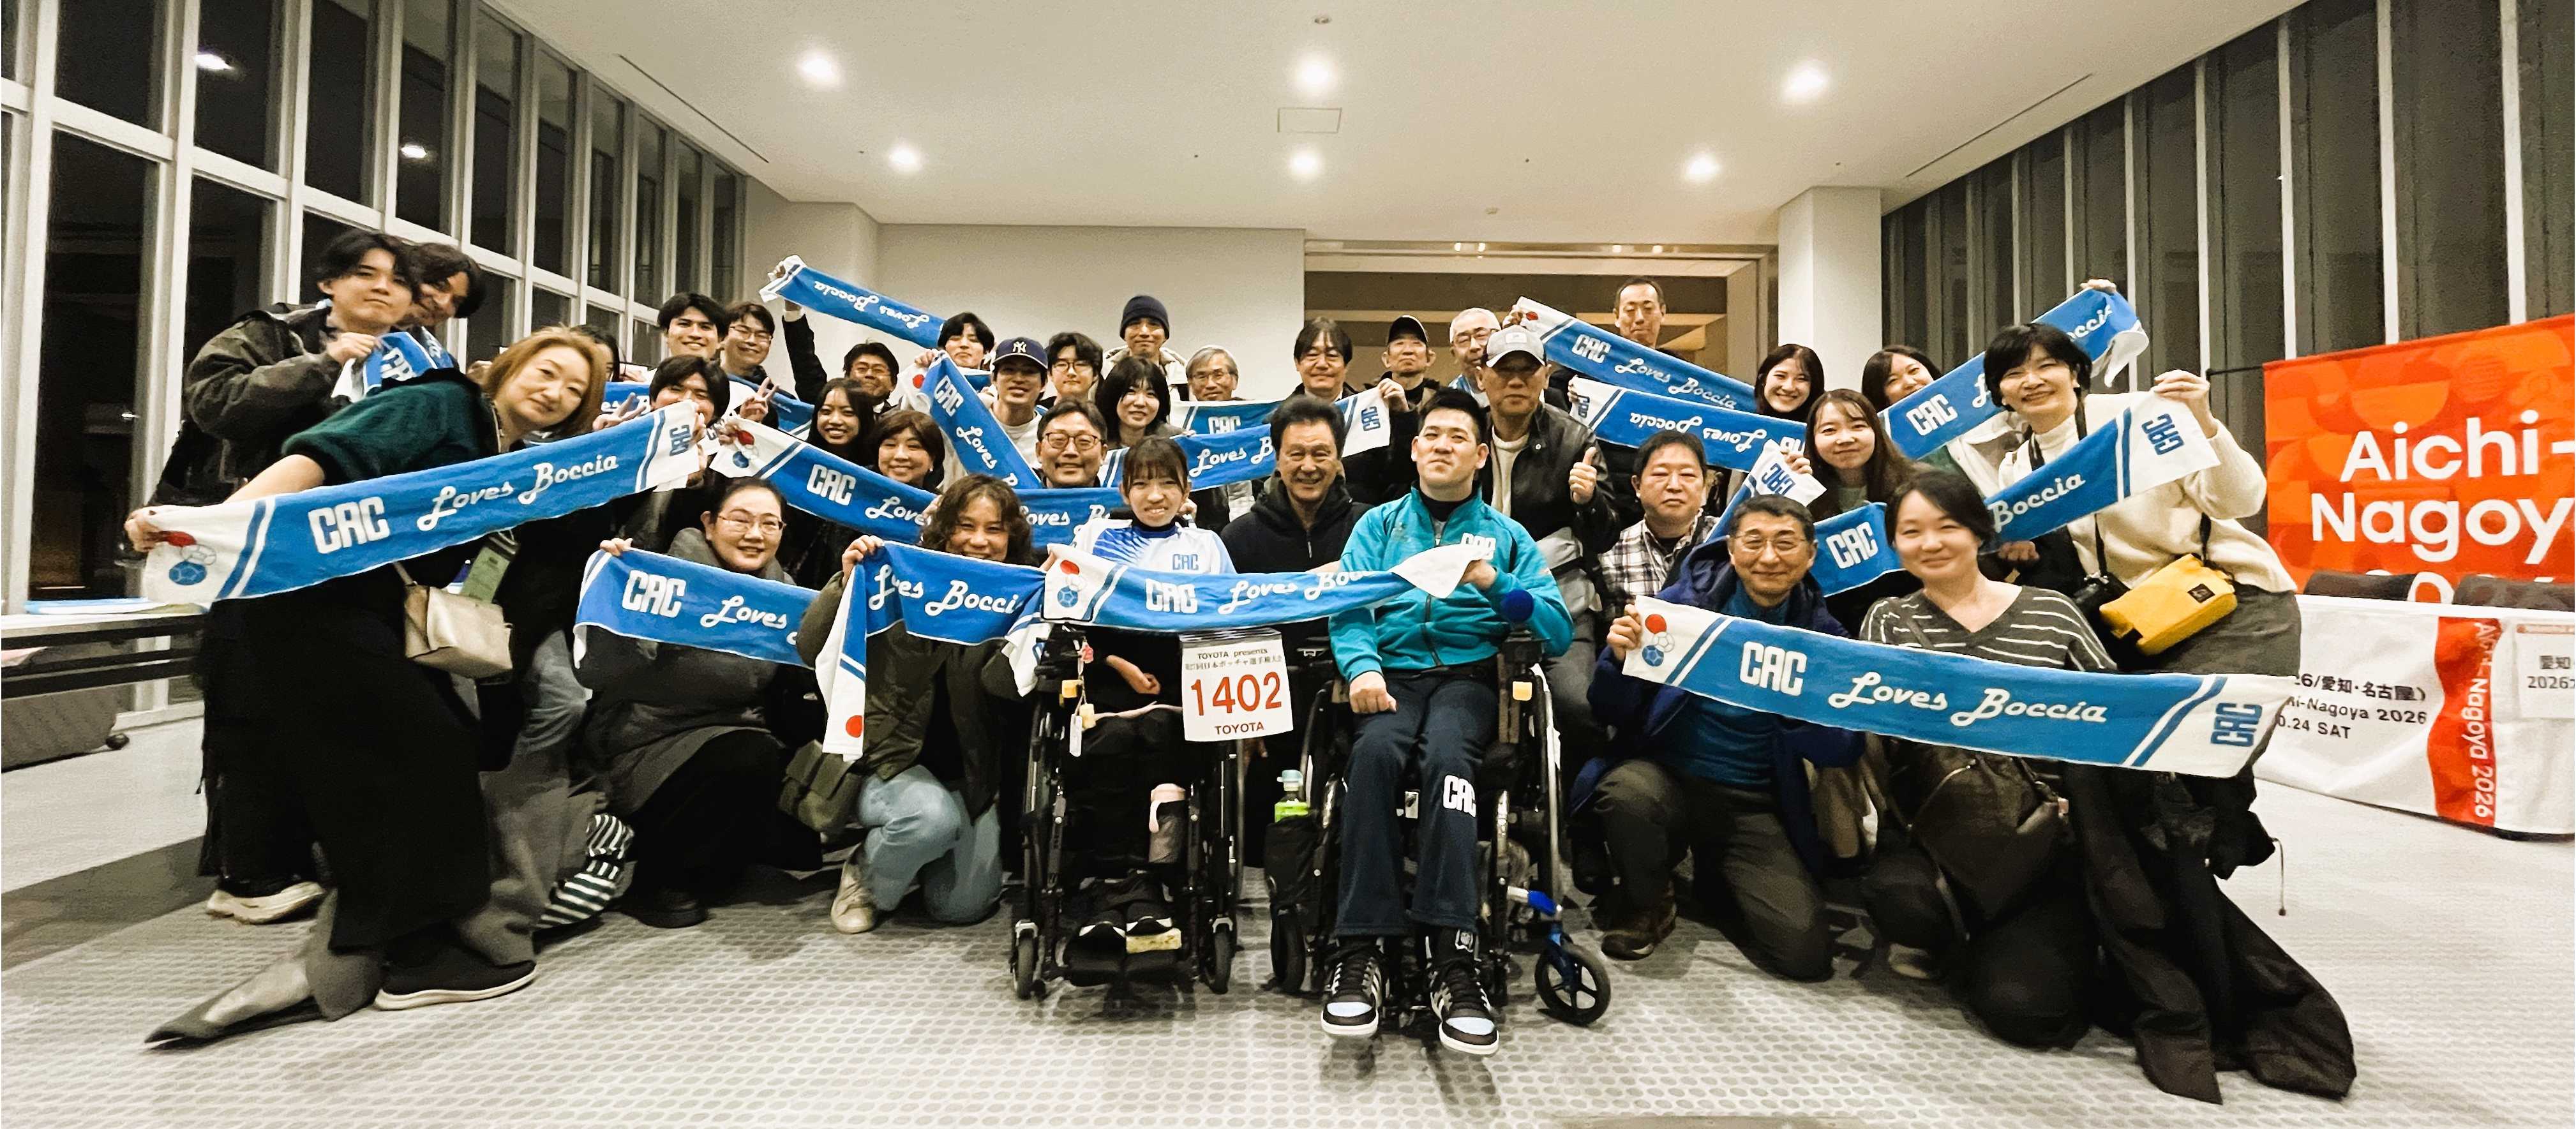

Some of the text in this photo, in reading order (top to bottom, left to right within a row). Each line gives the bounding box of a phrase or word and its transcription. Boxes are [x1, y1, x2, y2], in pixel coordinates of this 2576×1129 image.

[814, 281, 930, 329] Loves Boccia
[1013, 341, 1027, 353] NY
[1571, 334, 1737, 409] CAC Loves Boccia
[934, 375, 997, 469] CAC Loves
[1361, 406, 1381, 431] CAC
[1906, 393, 1958, 436] CAC
[2141, 413, 2185, 456] CAC
[670, 424, 692, 456] CAC
[1703, 428, 1767, 452] Loves
[2340, 409, 2575, 482] Aichi-
[1189, 447, 1247, 477] Loves
[308, 454, 619, 554] CAC Loves Boccia
[807, 464, 856, 506] CAC
[1988, 471, 2086, 534] Boccia
[1825, 521, 1878, 569] CAC
[2310, 493, 2575, 565] Nagoy
[1172, 553, 1199, 571] CAC
[622, 570, 787, 629] CAC Loves
[925, 579, 1023, 617] Bocci
[1145, 578, 1198, 613] CAC
[1218, 579, 1298, 615] Loves
[1198, 648, 1268, 660] TOYOTA presents
[1191, 671, 1282, 716] 1402
[1739, 641, 2108, 727] CAC Loves Boccia
[1215, 721, 1264, 735] TOYOTA
[2210, 703, 2262, 747] CAC
[2318, 722, 2351, 739] SAT
[2377, 709, 2427, 724] 2026
[2472, 765, 2495, 818] 2026
